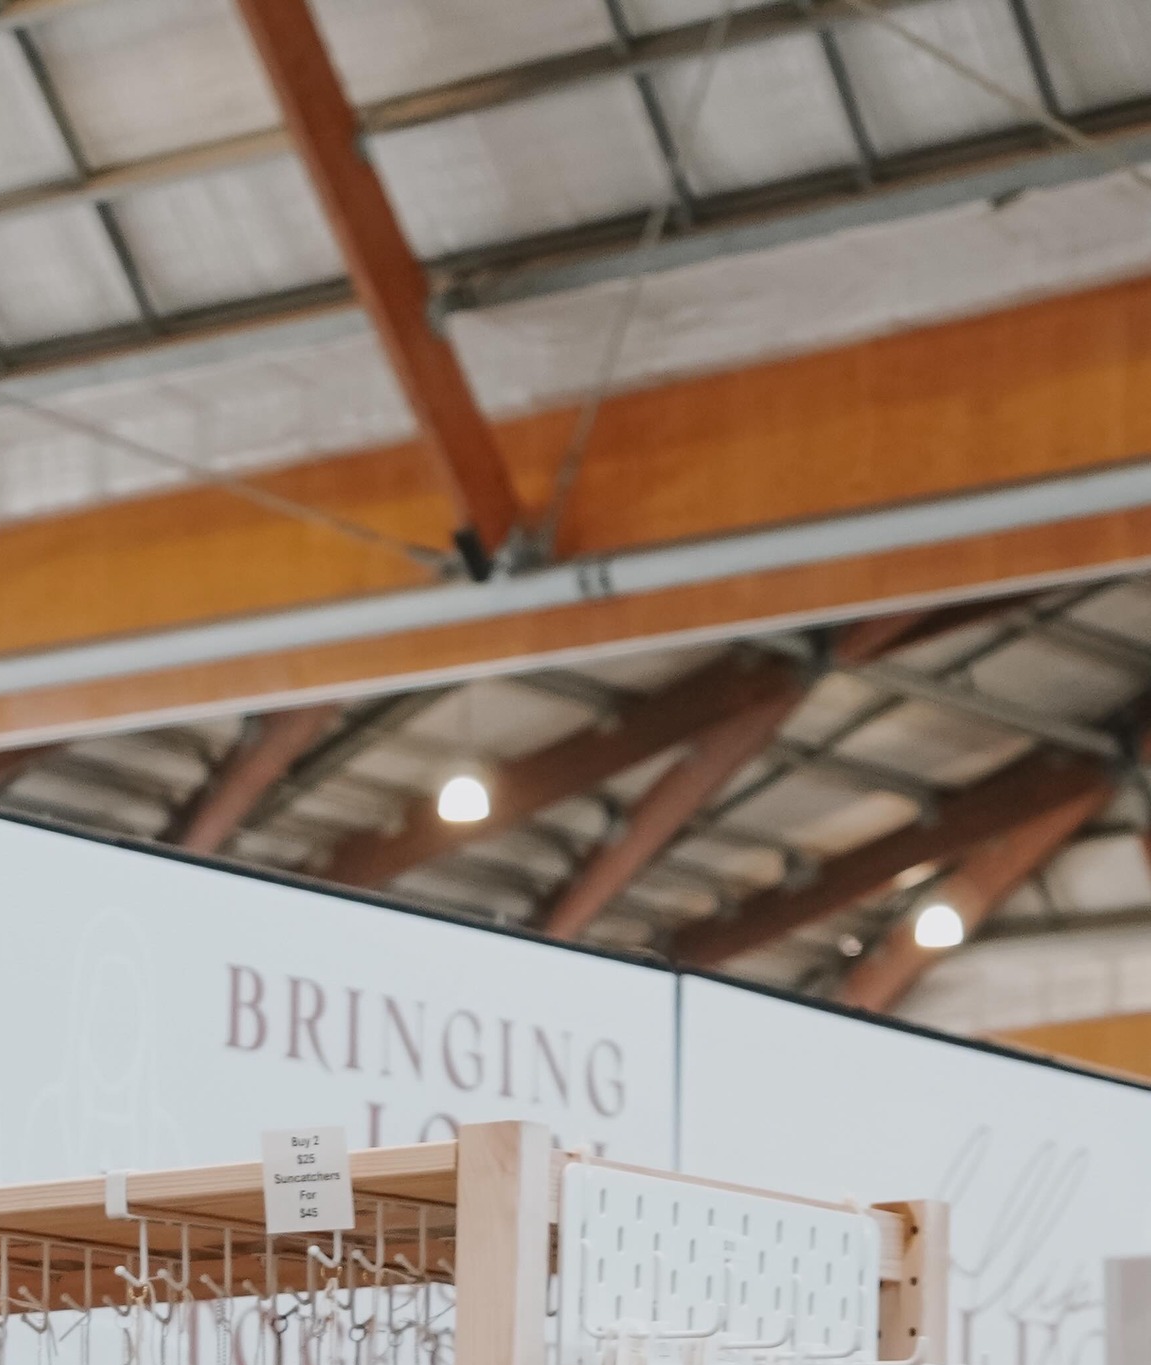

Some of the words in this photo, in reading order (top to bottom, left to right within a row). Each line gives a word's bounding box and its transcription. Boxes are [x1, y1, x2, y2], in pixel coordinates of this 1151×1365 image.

[225, 963, 626, 1118] BRINGING
[291, 1136, 310, 1148] Buy
[313, 1135, 319, 1146] 2
[297, 1154, 316, 1165] $25
[274, 1171, 340, 1185] Suncatchers
[299, 1190, 317, 1200] For
[299, 1207, 319, 1219] $45
